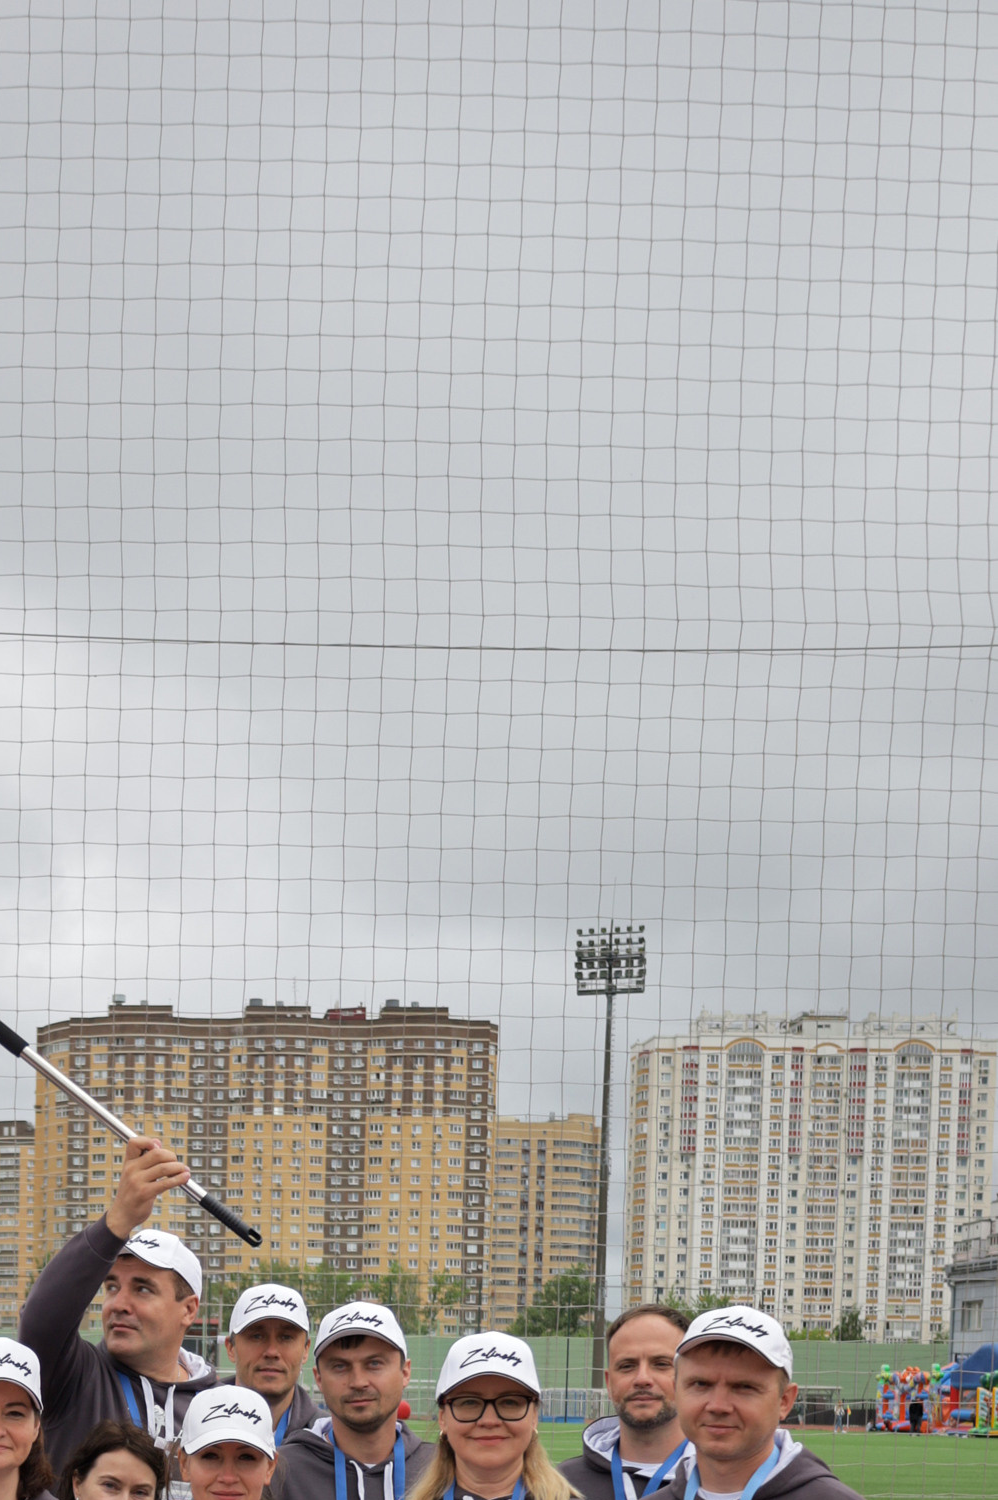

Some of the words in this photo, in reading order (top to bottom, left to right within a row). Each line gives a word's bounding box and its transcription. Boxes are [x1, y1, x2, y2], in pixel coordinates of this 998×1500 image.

[127, 1234, 160, 1249] elinsky
[244, 1294, 298, 1314] Zelinsky
[329, 1311, 384, 1333] Zelinsky
[701, 1316, 769, 1338] Zelinsky
[459, 1347, 522, 1369] Zelinsky
[202, 1402, 262, 1424] Zelinsky
